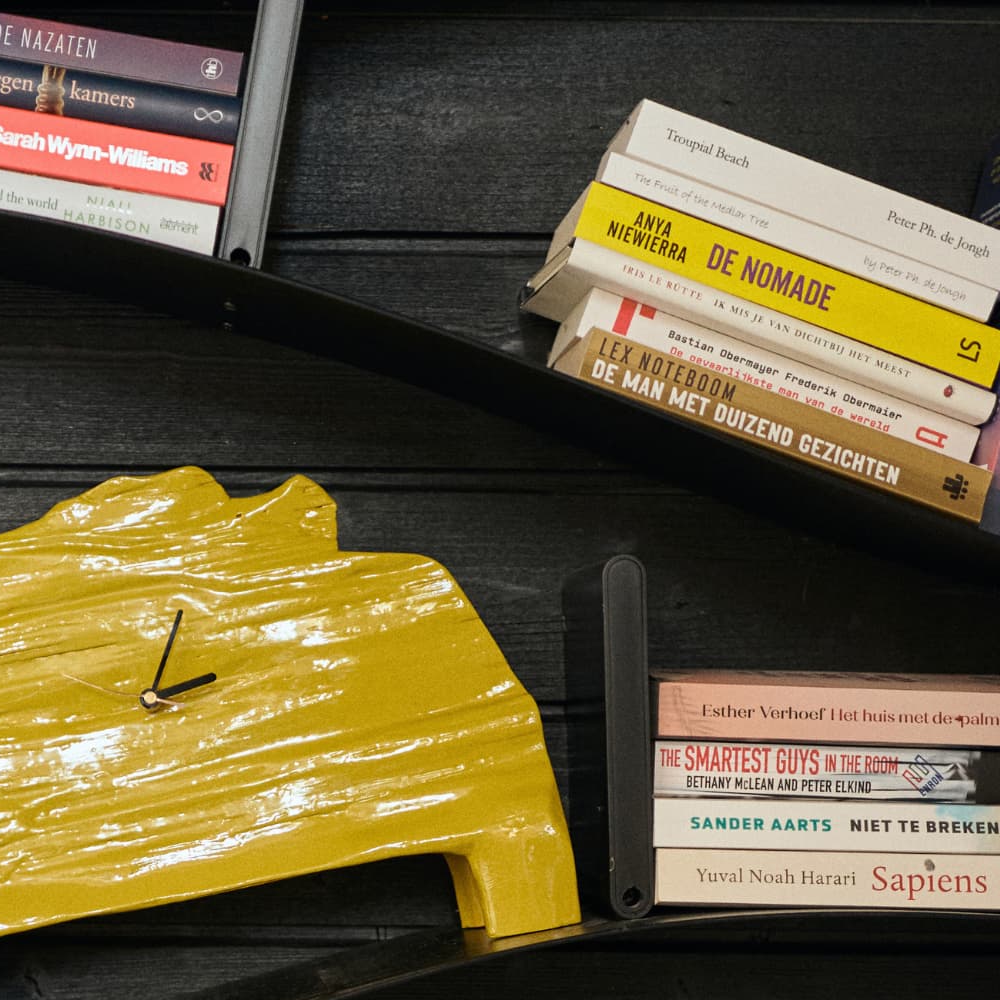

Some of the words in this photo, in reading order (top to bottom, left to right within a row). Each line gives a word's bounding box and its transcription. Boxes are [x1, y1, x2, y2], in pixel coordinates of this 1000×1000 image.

[20, 28, 97, 60] NAZATEN
[69, 80, 136, 109] kamers
[48, 135, 189, 176] Wynn-Williams
[6, 191, 26, 205] the
[27, 196, 59, 211] world
[666, 127, 714, 156] Troupial
[715, 146, 750, 169] Beach
[887, 209, 917, 232] Peter
[918, 221, 937, 239] Ph.
[940, 230, 955, 245] de
[953, 235, 991, 260] Jongh
[63, 209, 151, 235] HARBISON
[633, 210, 672, 238] ANYA
[634, 172, 651, 186] The
[654, 179, 679, 197] Fruit
[681, 189, 693, 205] of
[694, 193, 709, 209] the
[749, 213, 770, 230] Tree
[863, 255, 878, 272] by
[879, 261, 903, 277] Peter
[606, 220, 688, 264] NIEWIERRA
[706, 242, 740, 276] DE
[740, 255, 836, 312] NOMADE
[622, 264, 646, 279] IRIS
[649, 273, 662, 286] LE
[713, 298, 726, 310] IK
[728, 304, 750, 318] MIS
[750, 312, 764, 324] JE
[768, 319, 791, 334] VAN
[793, 328, 846, 355] DICHTBIJ
[848, 348, 871, 363] HET
[874, 358, 912, 379] MEEST
[598, 336, 634, 365] LEX
[638, 351, 737, 402] NOTEBOOM
[667, 329, 715, 354] Bastian
[719, 348, 779, 376] Obermayer
[784, 372, 838, 398] Frederik
[842, 393, 903, 421] Obermaier
[669, 346, 684, 358] De
[778, 386, 800, 400] man
[804, 396, 825, 409] van
[830, 405, 844, 417] de
[849, 413, 891, 433] wereld
[591, 358, 619, 386] DE
[621, 369, 665, 401] MAN
[668, 386, 711, 418] MET
[713, 403, 794, 447] DUIZEND
[798, 433, 901, 486] GEZICHTEN
[702, 704, 755, 719] Esther
[760, 705, 826, 721] Verhoef
[830, 708, 859, 722] Het
[863, 708, 895, 723] huis
[899, 711, 929, 724] met
[932, 711, 953, 725] de
[660, 748, 681, 767] THE
[684, 745, 772, 774] SMARTEST
[776, 747, 820, 775] GUYS
[825, 753, 837, 772] IN
[840, 754, 862, 774] THE
[865, 755, 899, 775] ROOM
[686, 775, 732, 789] BETHANY
[734, 776, 775, 791] McLEAN
[777, 778, 798, 792] AND
[801, 778, 832, 793] PETER
[835, 780, 872, 794] ELKIND
[690, 816, 764, 830] SANDER
[770, 818, 832, 832] AARTS
[850, 819, 893, 833] NIET
[898, 820, 920, 833] TE
[926, 820, 999, 835] BREKEN
[696, 868, 743, 883] Yuval
[749, 868, 795, 885] Noah
[801, 870, 857, 886] Harari
[871, 865, 988, 900] Sapiens
